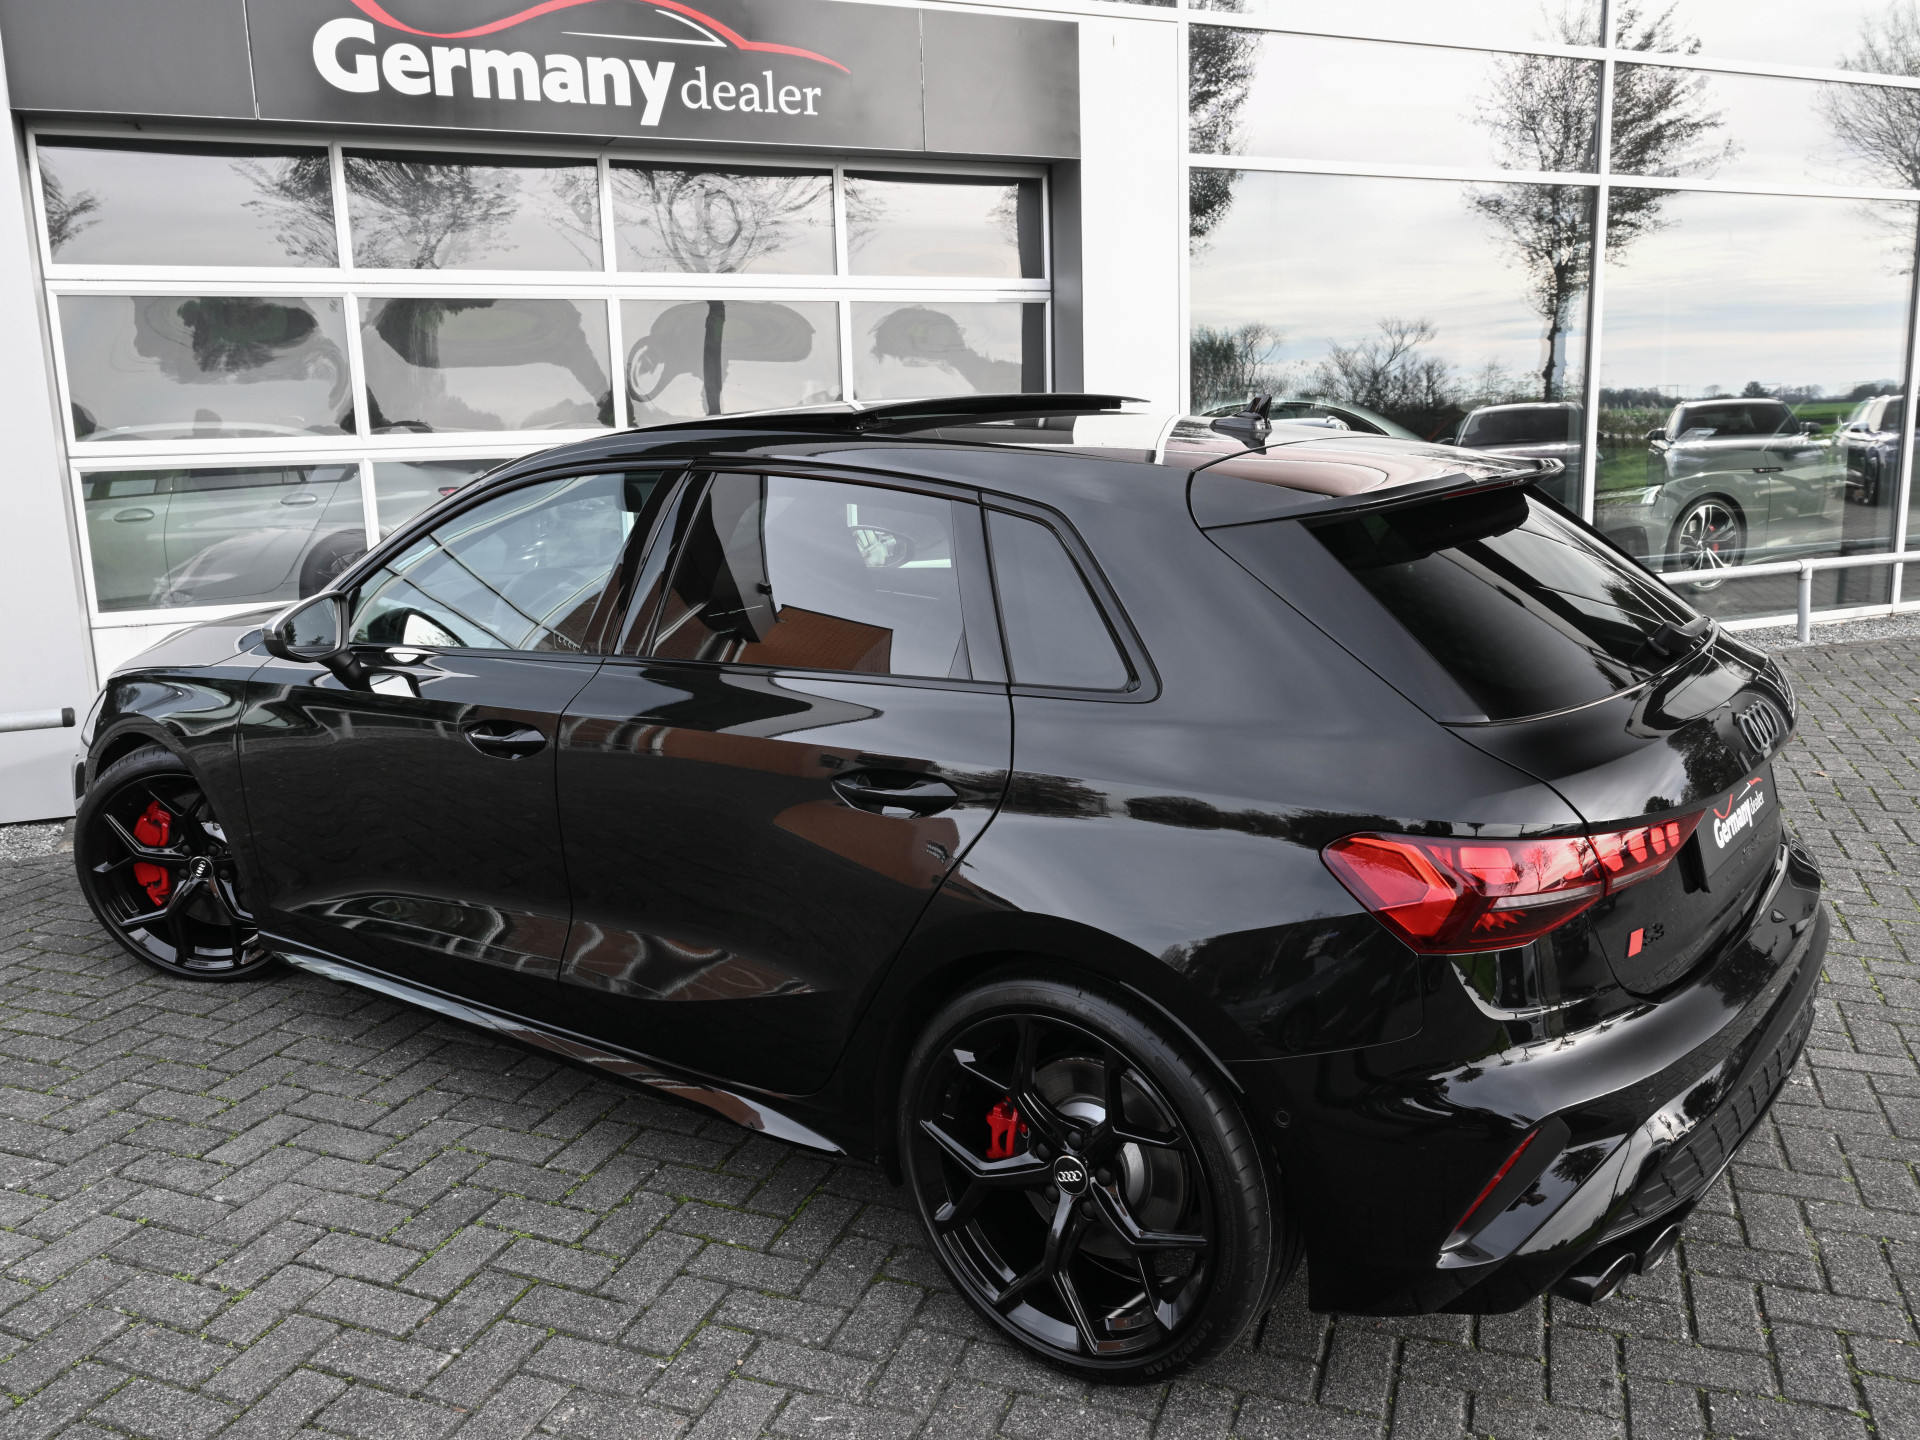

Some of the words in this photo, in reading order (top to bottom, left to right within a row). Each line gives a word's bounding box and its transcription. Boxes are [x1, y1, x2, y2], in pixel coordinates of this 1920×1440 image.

[312, 17, 675, 126] Germany
[680, 65, 822, 116] dealer
[1714, 798, 1753, 848] Germany
[1750, 790, 1765, 815] dealer
[1143, 1319, 1213, 1376] GOODYEAR
